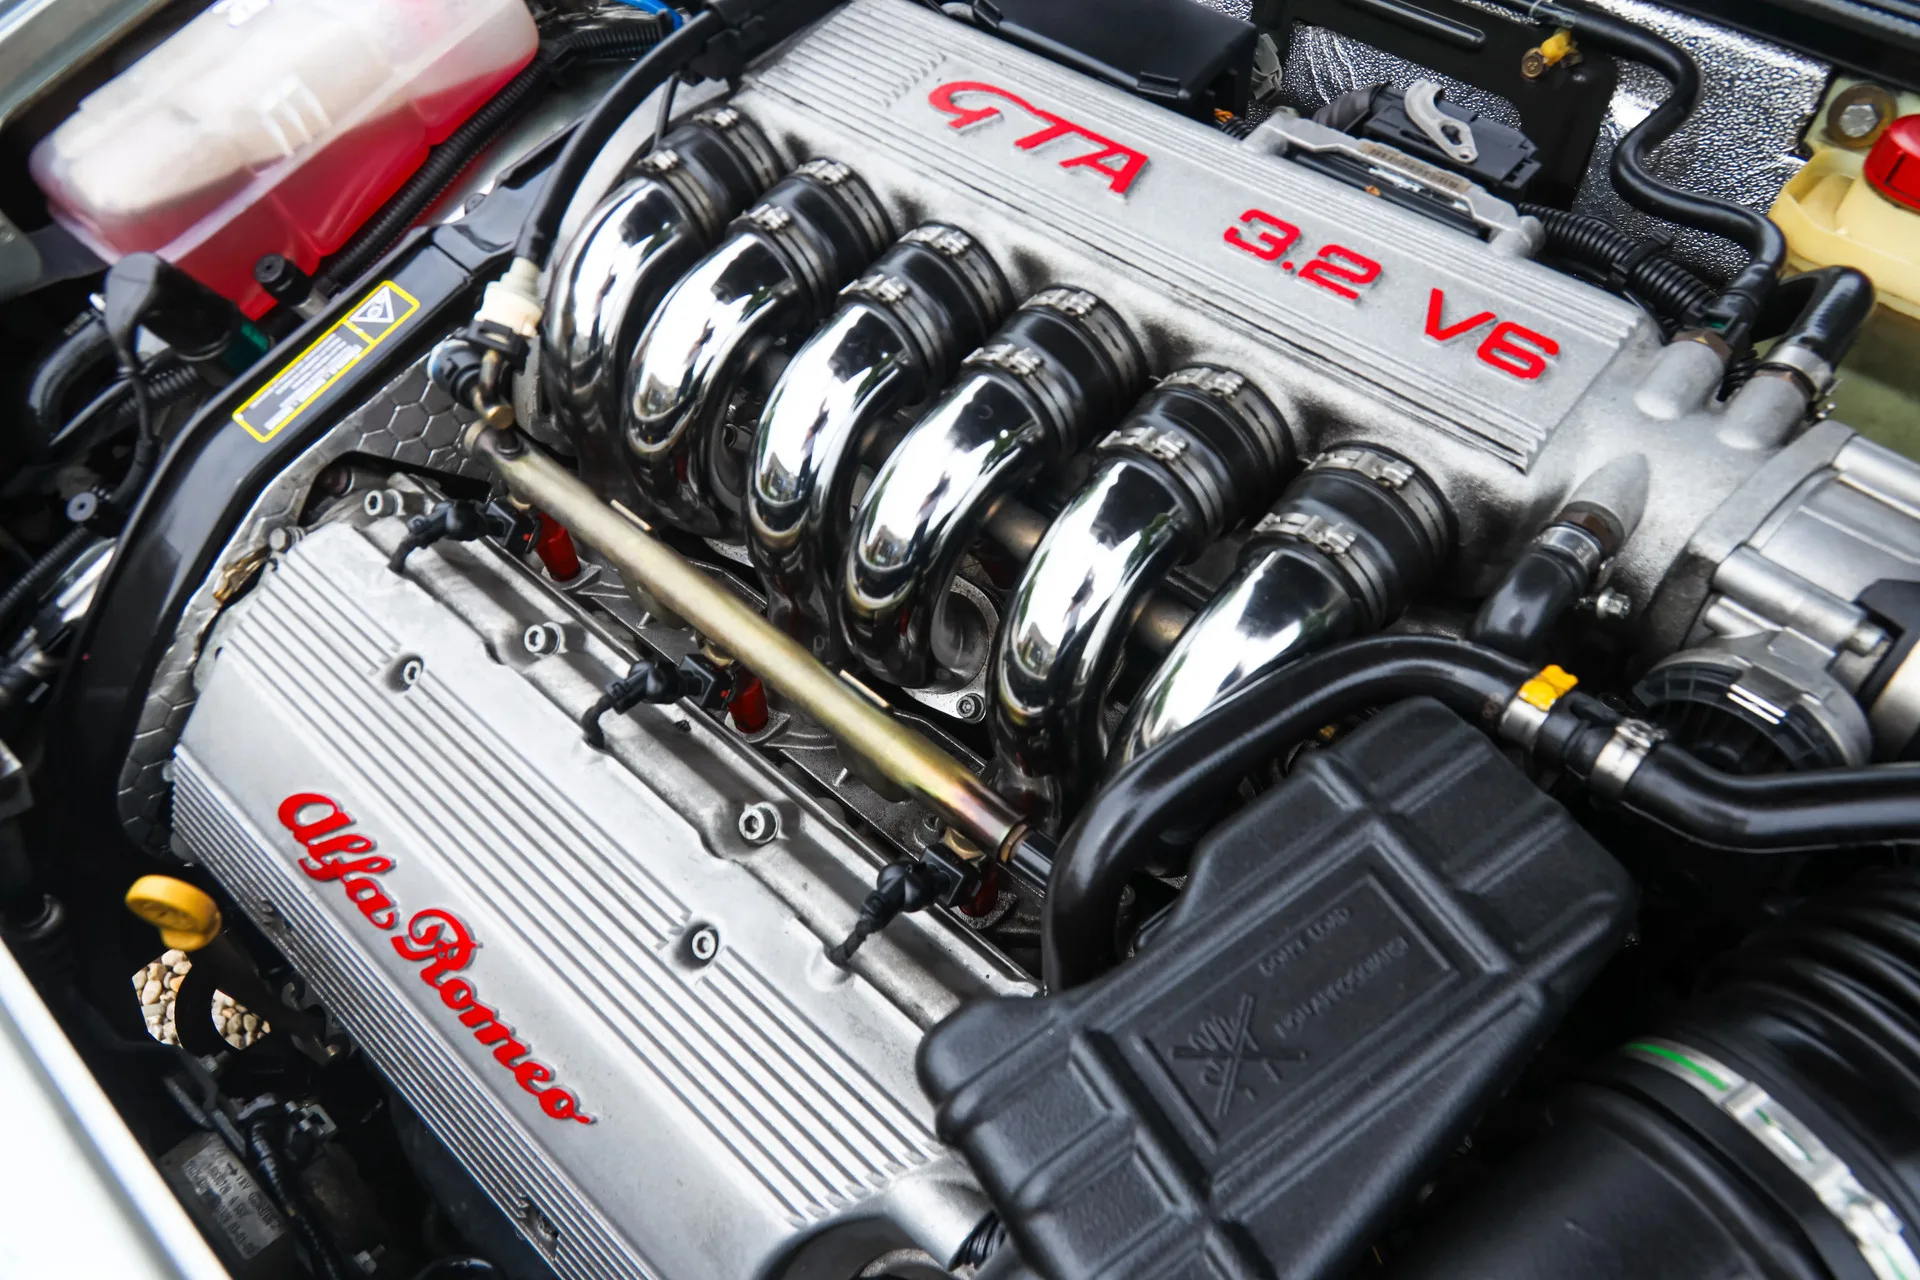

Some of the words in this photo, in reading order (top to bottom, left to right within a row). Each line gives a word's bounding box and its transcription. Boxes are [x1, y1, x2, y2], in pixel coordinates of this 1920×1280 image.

[928, 80, 1149, 194] GTA
[1223, 208, 1383, 301] 3.2
[1424, 287, 1561, 380] V6
[277, 792, 396, 930] Alfa
[390, 908, 592, 1125] Romeo
